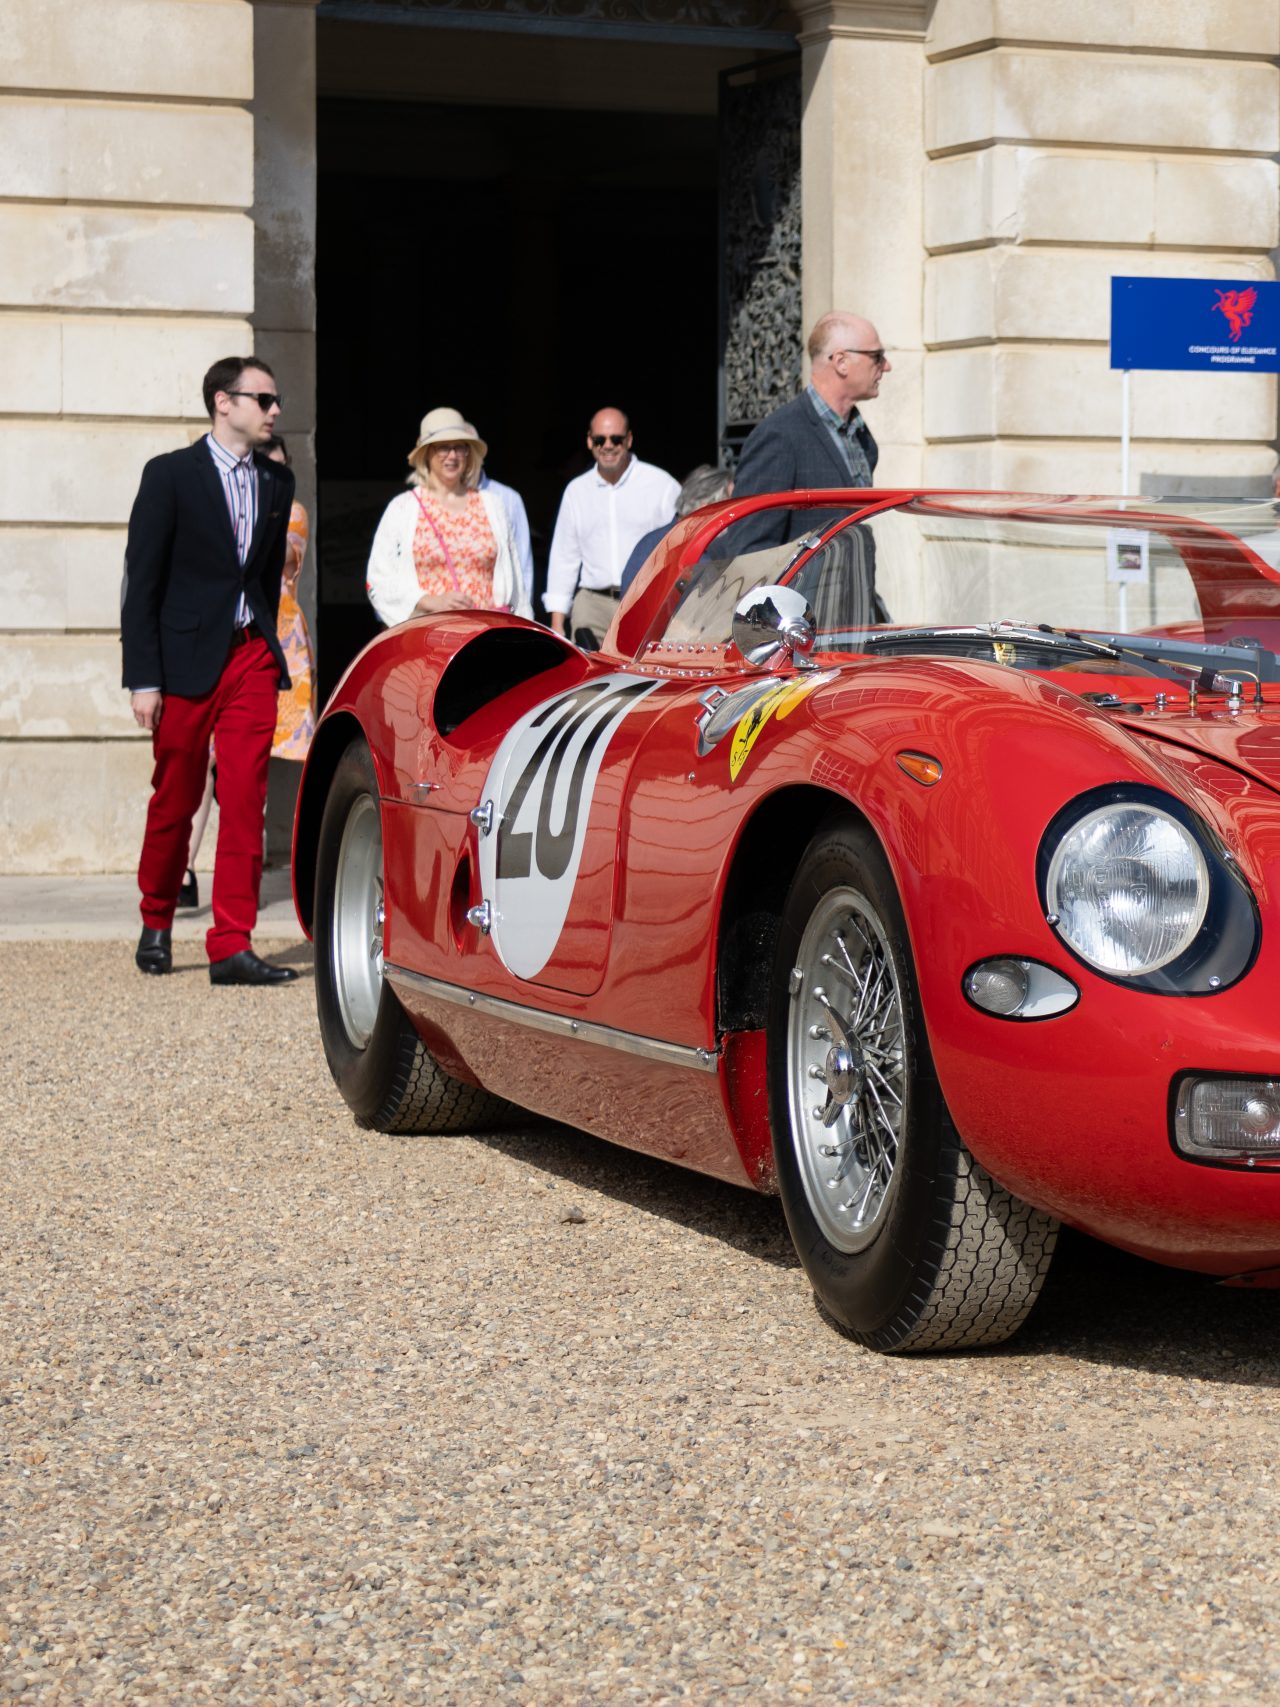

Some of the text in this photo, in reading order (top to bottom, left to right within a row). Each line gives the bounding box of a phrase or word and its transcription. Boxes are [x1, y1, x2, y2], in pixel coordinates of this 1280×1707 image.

[1188, 345, 1277, 356] CONCOURS OF ELEGANCE
[1210, 355, 1256, 364] PROGRAMME
[496, 680, 658, 880] 20
